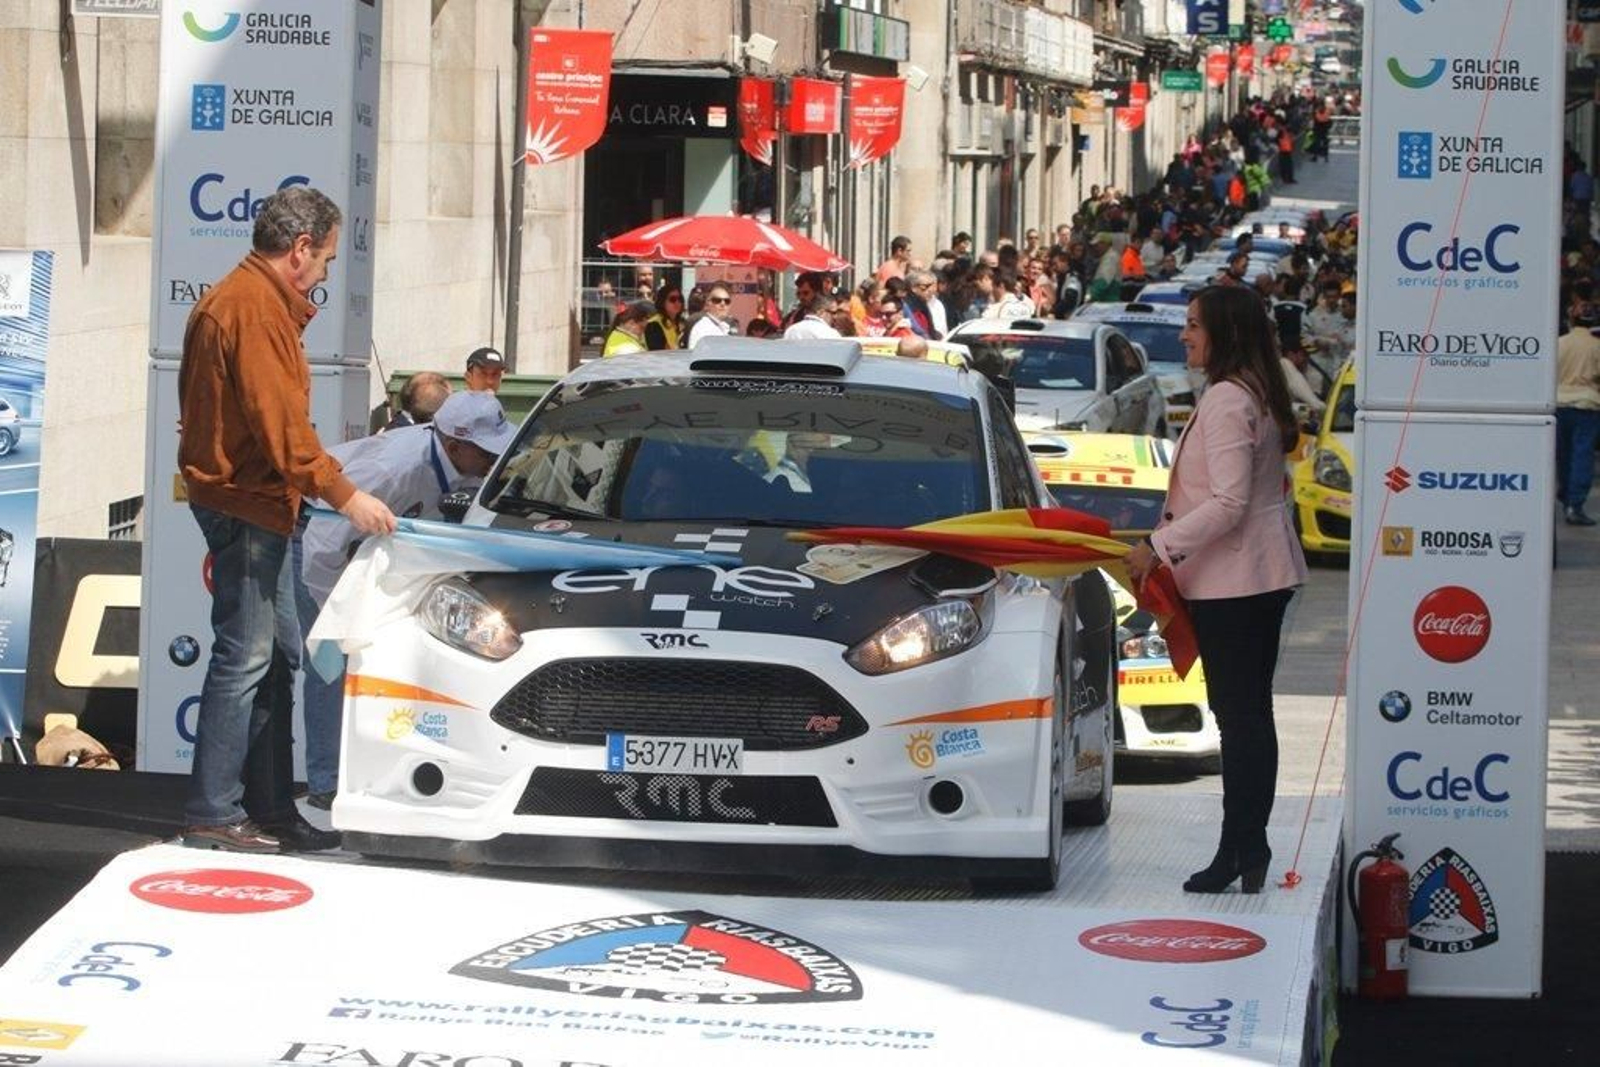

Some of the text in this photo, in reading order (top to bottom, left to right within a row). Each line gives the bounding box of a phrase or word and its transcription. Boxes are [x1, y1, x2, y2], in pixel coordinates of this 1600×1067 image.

[246, 13, 311, 29] GALICIA
[246, 30, 331, 46] SAUDABLE
[1452, 58, 1520, 74] GALICIA
[1452, 76, 1540, 92] SAUDABLE
[233, 89, 295, 106] XUNTA
[231, 108, 333, 127] DE GALICIA
[630, 104, 695, 125] CLARA
[1439, 136, 1503, 153] XUNTA
[1438, 156, 1543, 174] DE GALICIA
[189, 226, 249, 238] servicios
[1397, 222, 1521, 273] CdeC
[1397, 275, 1520, 290] servicios gráficos
[1378, 331, 1540, 357] FARO DE VIGO
[1430, 357, 1490, 368] Diario Oficial
[1418, 471, 1528, 491] SUZUKI
[1421, 531, 1493, 549] RODOSA
[709, 592, 795, 609] watch
[1417, 611, 1489, 636] Coca-Cola
[1427, 692, 1473, 706] BMW
[423, 711, 448, 725] Costa
[806, 715, 841, 732] RS
[1426, 709, 1522, 726] Celtamotor
[414, 723, 449, 738] Blanca
[941, 728, 978, 744] Costa
[612, 757, 620, 766] E
[625, 740, 687, 767] 5377
[936, 739, 982, 757] Blanca
[1387, 751, 1510, 803] CdeC
[598, 773, 757, 819] RMC
[1387, 805, 1509, 820] servicios gráficos
[139, 879, 300, 902] Coca-Cola
[469, 914, 687, 970] ESCUDERIA
[1089, 932, 1251, 950] Coca-Cola
[1423, 940, 1473, 954] VIGO
[568, 982, 758, 1004] VIGO
[338, 997, 936, 1040] www.rallyeriasbaixas.com
[378, 1012, 474, 1024] Rallye
[562, 1022, 666, 1035] Baixas
